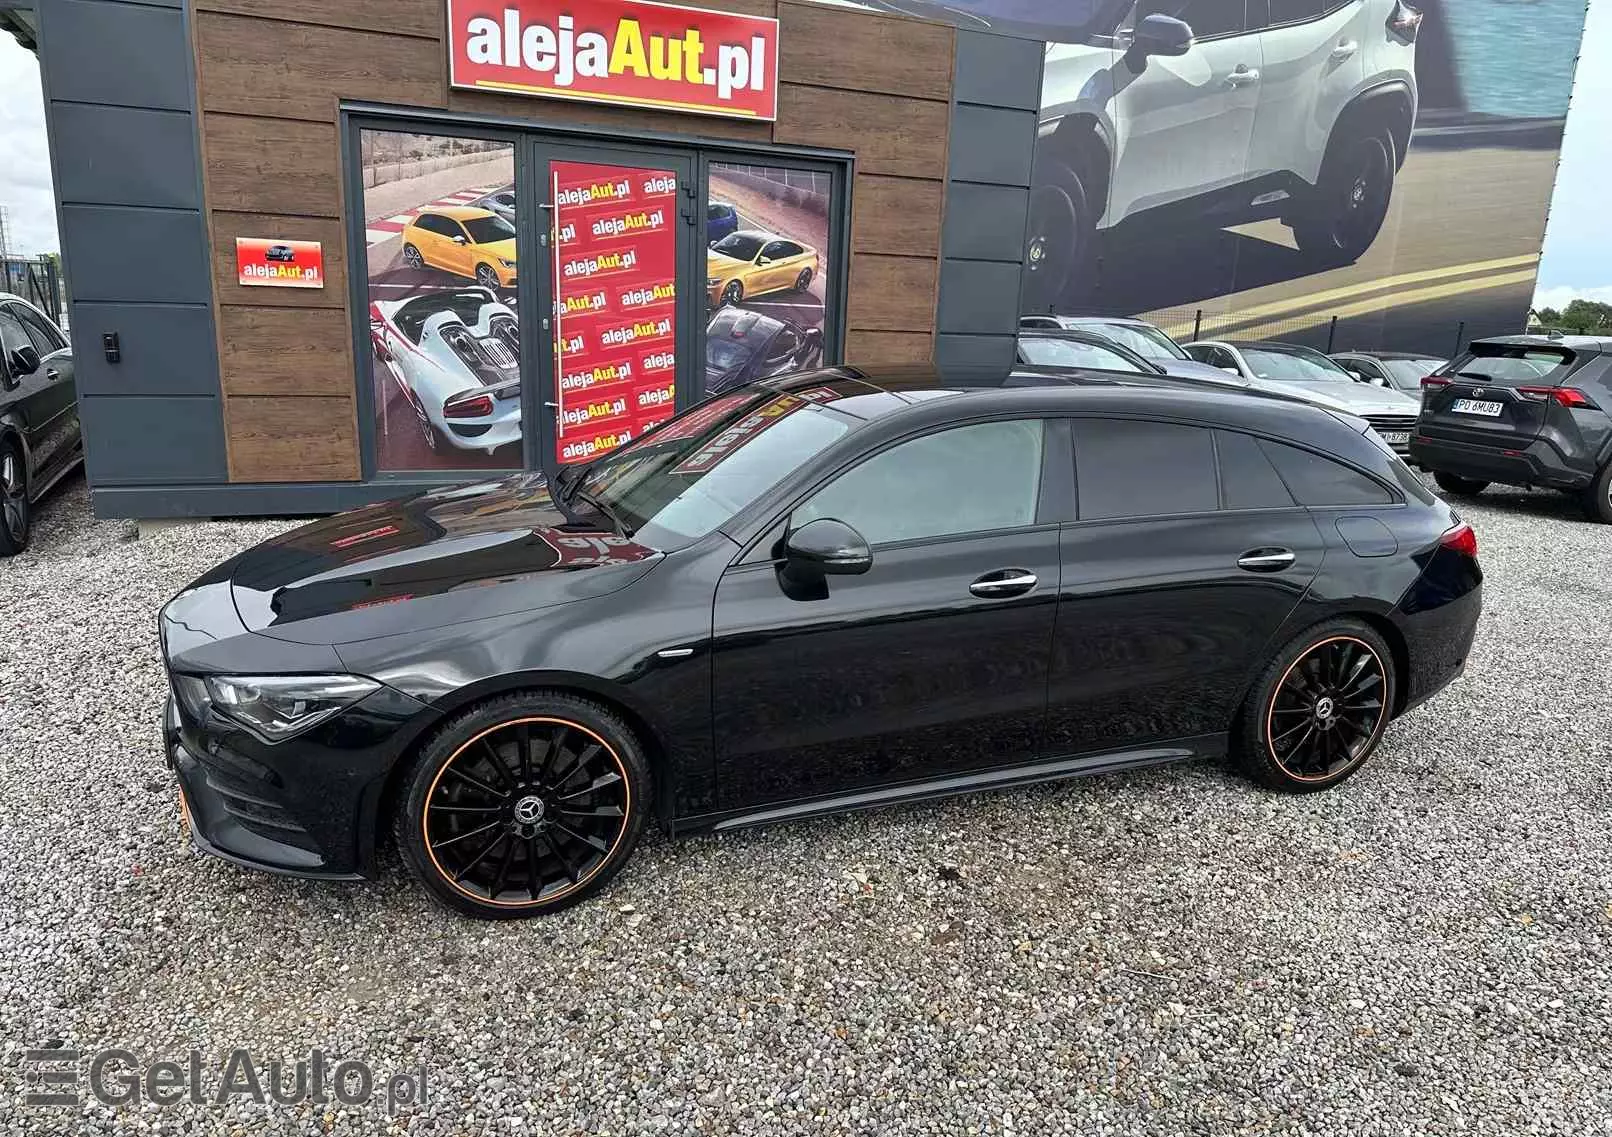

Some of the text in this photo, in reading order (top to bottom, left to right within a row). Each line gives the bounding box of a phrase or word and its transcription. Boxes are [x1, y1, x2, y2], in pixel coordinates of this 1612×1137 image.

[466, 8, 765, 100] alejaAut.pl
[558, 179, 631, 205] alejaAut.pl
[643, 176, 675, 195] aleja
[592, 210, 664, 236] alejaAut.pl
[243, 263, 318, 280] alejaAut.pl
[563, 250, 636, 276] alejaAut.pl
[621, 283, 675, 306] alejaAut
[601, 319, 671, 344] alejaAut.pl
[643, 352, 675, 370] aleja
[561, 362, 632, 389] alejaAut.pl
[562, 430, 632, 458] alejaAut.pl
